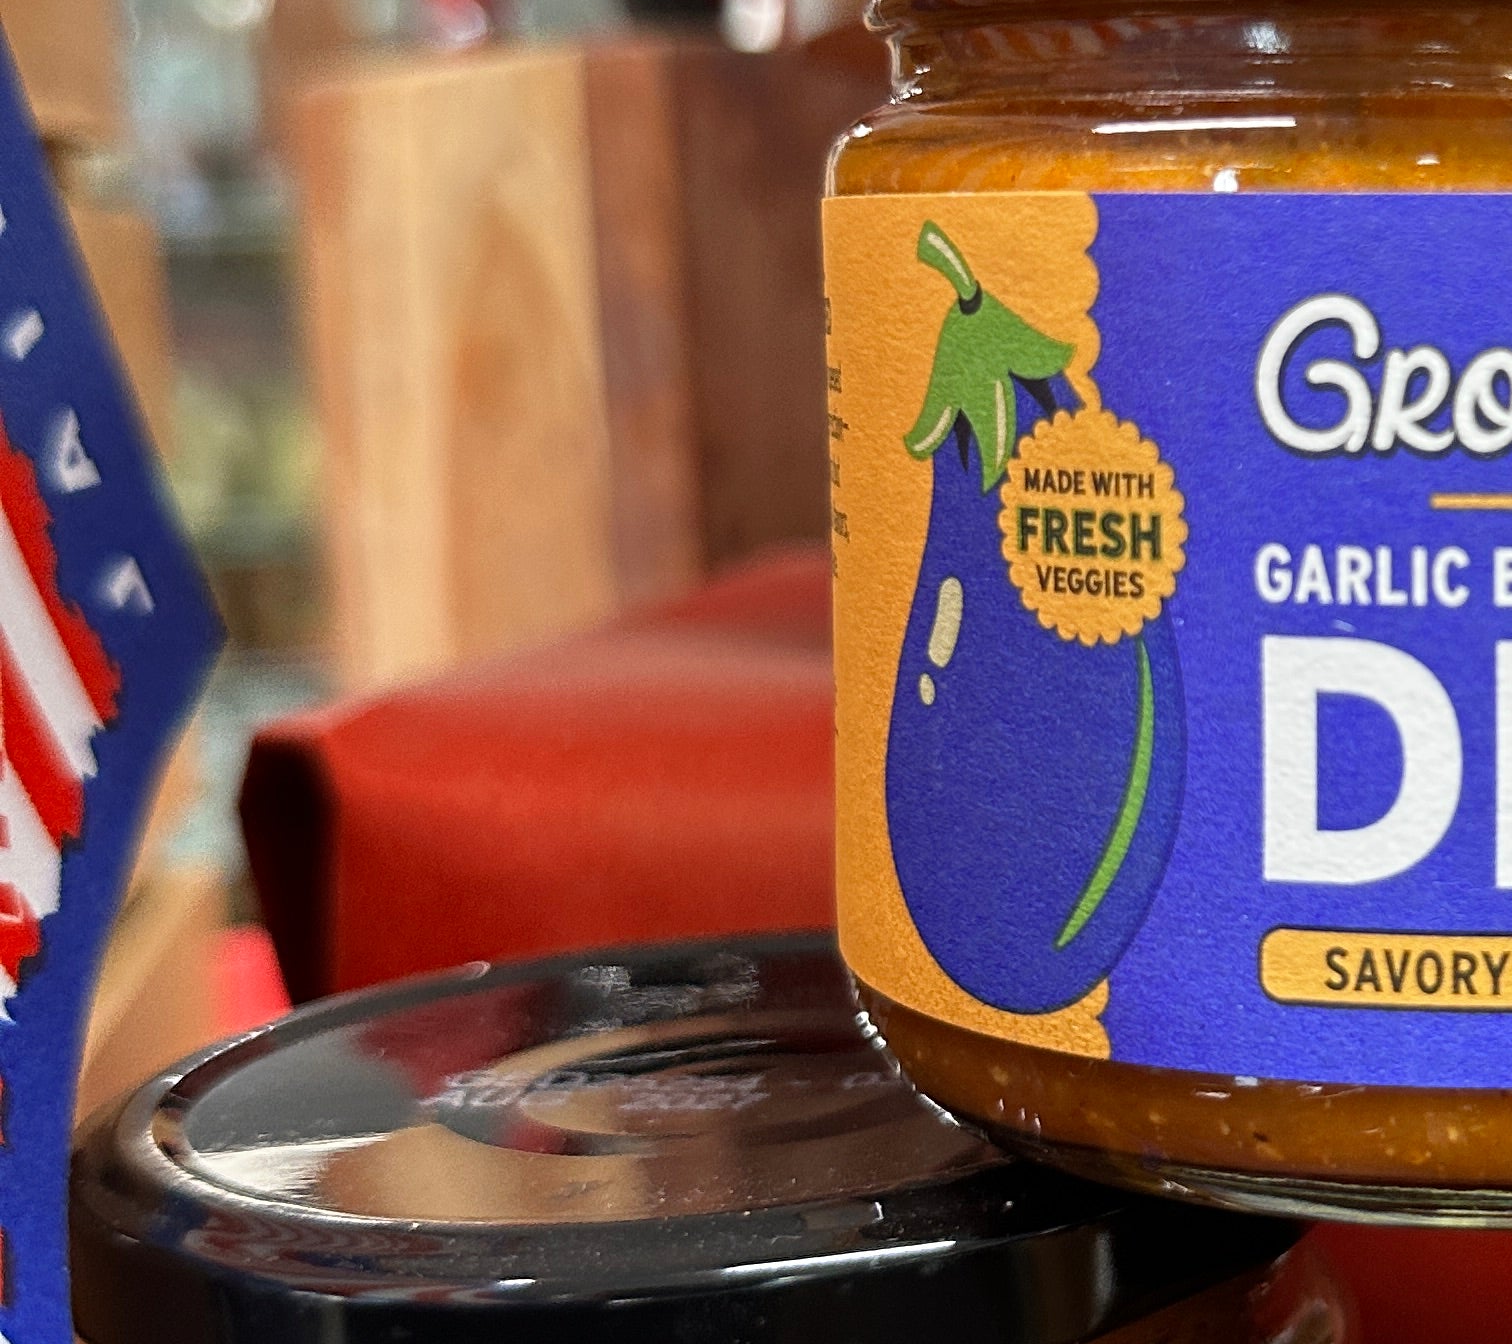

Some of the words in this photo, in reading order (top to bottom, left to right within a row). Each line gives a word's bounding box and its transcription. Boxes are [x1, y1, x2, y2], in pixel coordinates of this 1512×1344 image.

[1024, 468, 1086, 495] MADE
[1092, 471, 1155, 499] WITH
[1017, 506, 1162, 560] FRESH
[1035, 564, 1145, 599] VEGGIES
[1255, 542, 1470, 607] GARLIC
[1324, 946, 1511, 995] SAVORY
